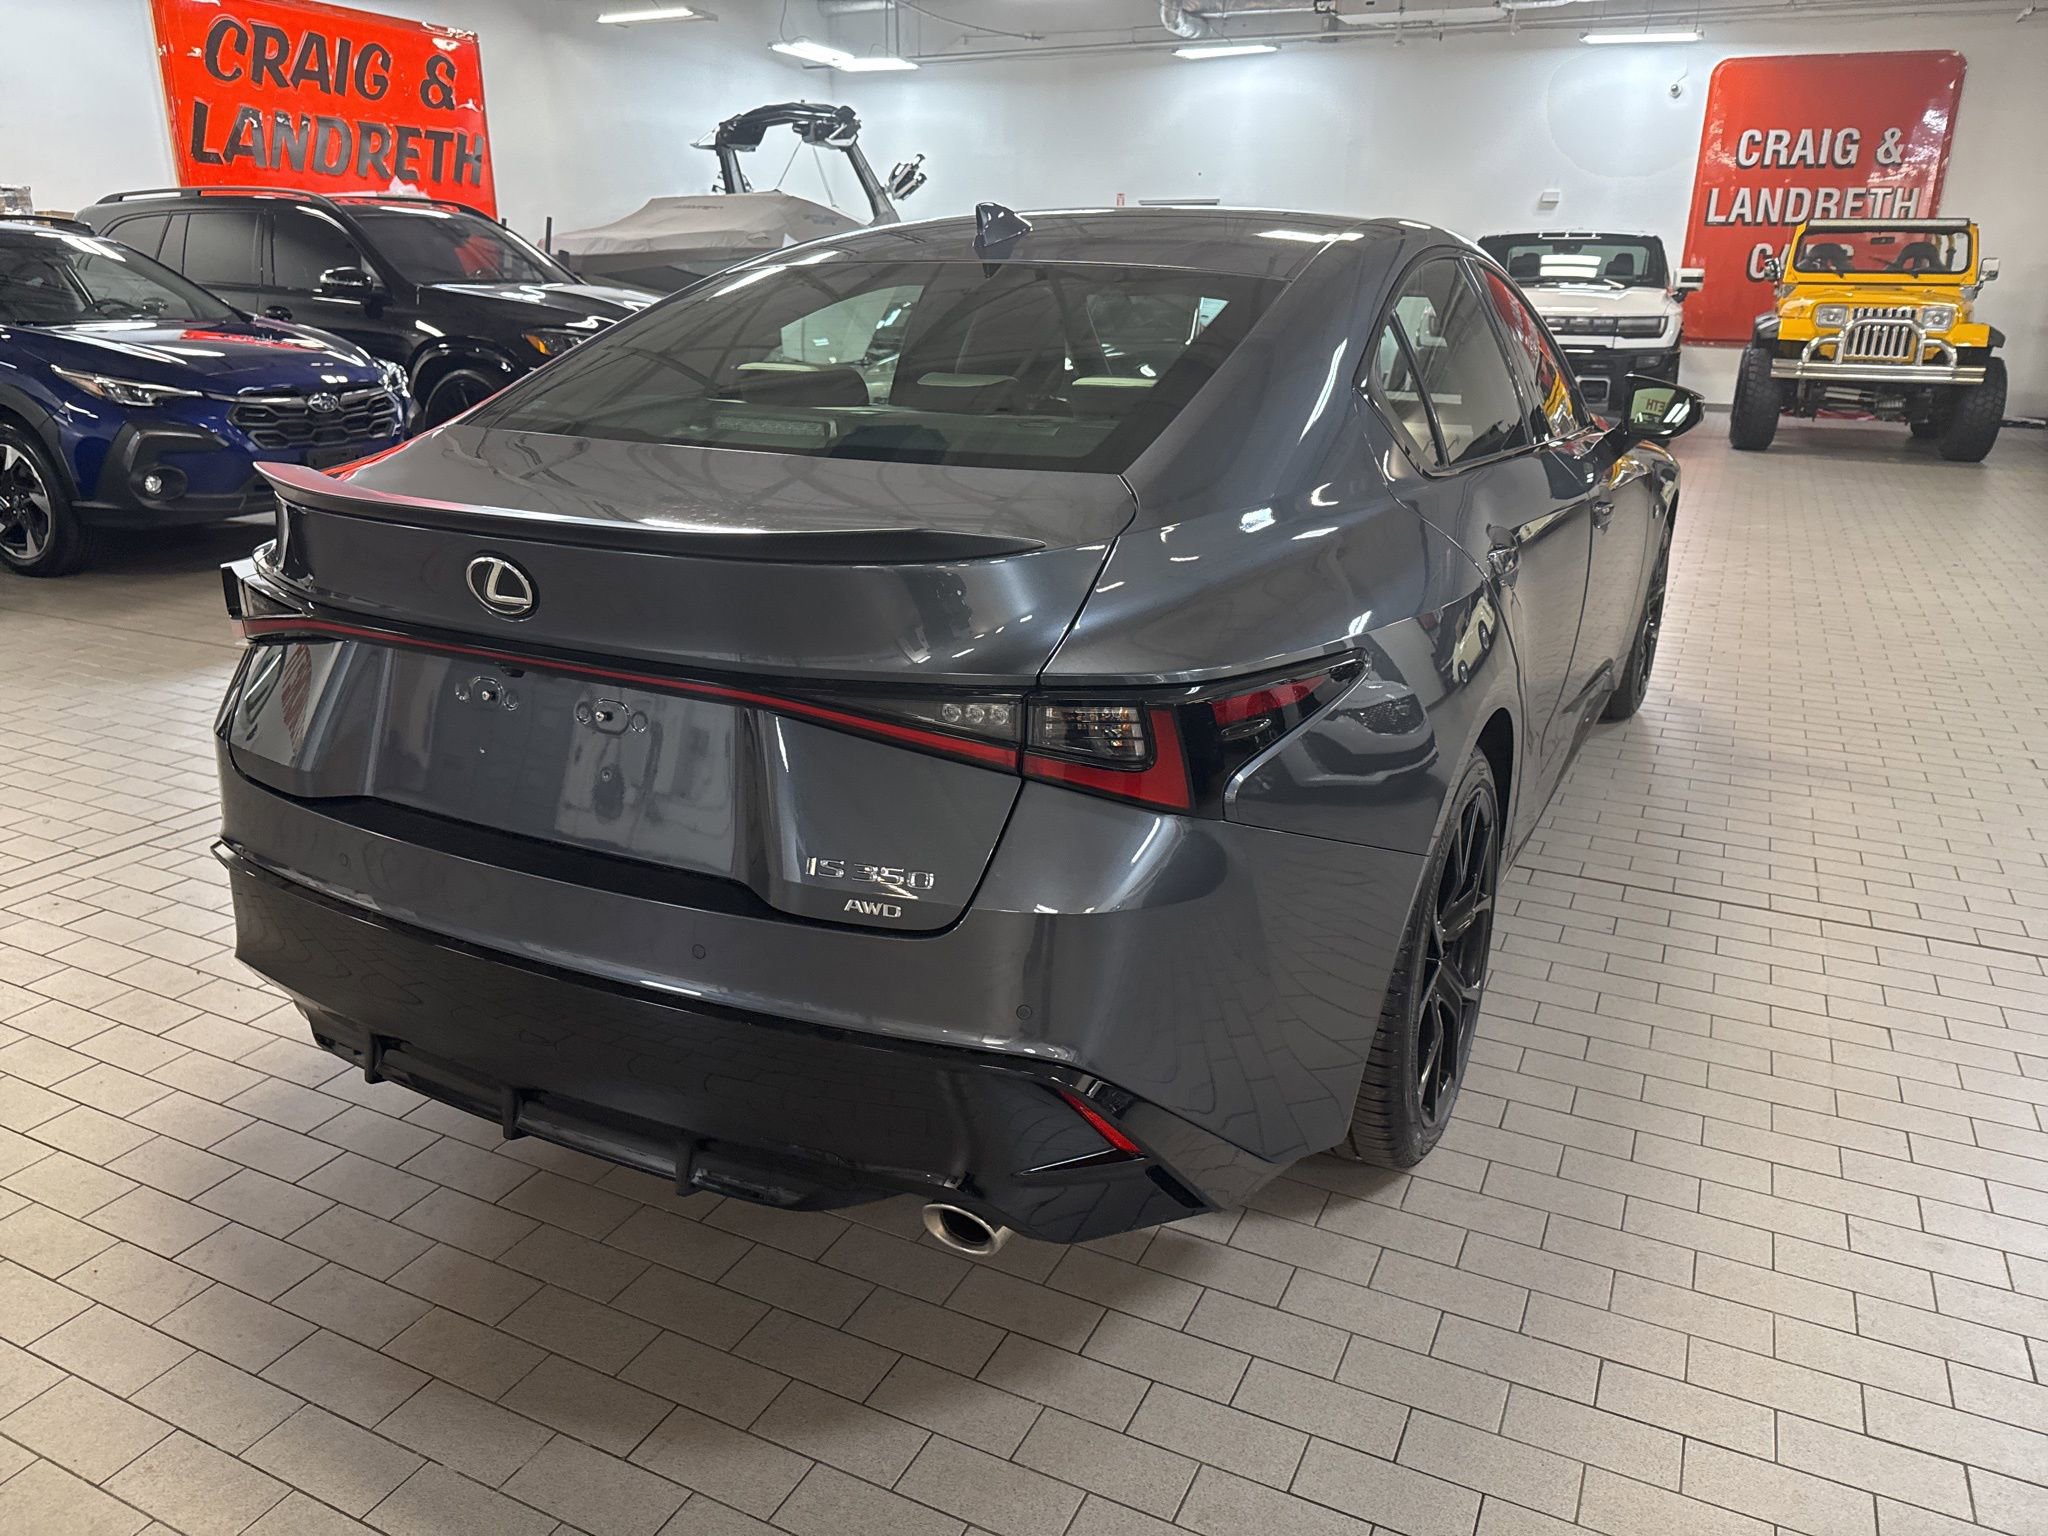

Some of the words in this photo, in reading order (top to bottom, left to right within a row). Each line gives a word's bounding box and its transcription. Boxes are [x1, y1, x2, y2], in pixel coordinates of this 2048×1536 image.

[204, 18, 392, 101] CRAIG
[419, 53, 457, 110] &
[189, 100, 484, 187] LANDRETH
[1737, 127, 1861, 169] CRAIG
[1875, 127, 1905, 166] &
[1705, 186, 1921, 226] LANDRETH
[805, 856, 845, 878] IS
[852, 863, 935, 890] 350
[843, 898, 902, 918] AWD
